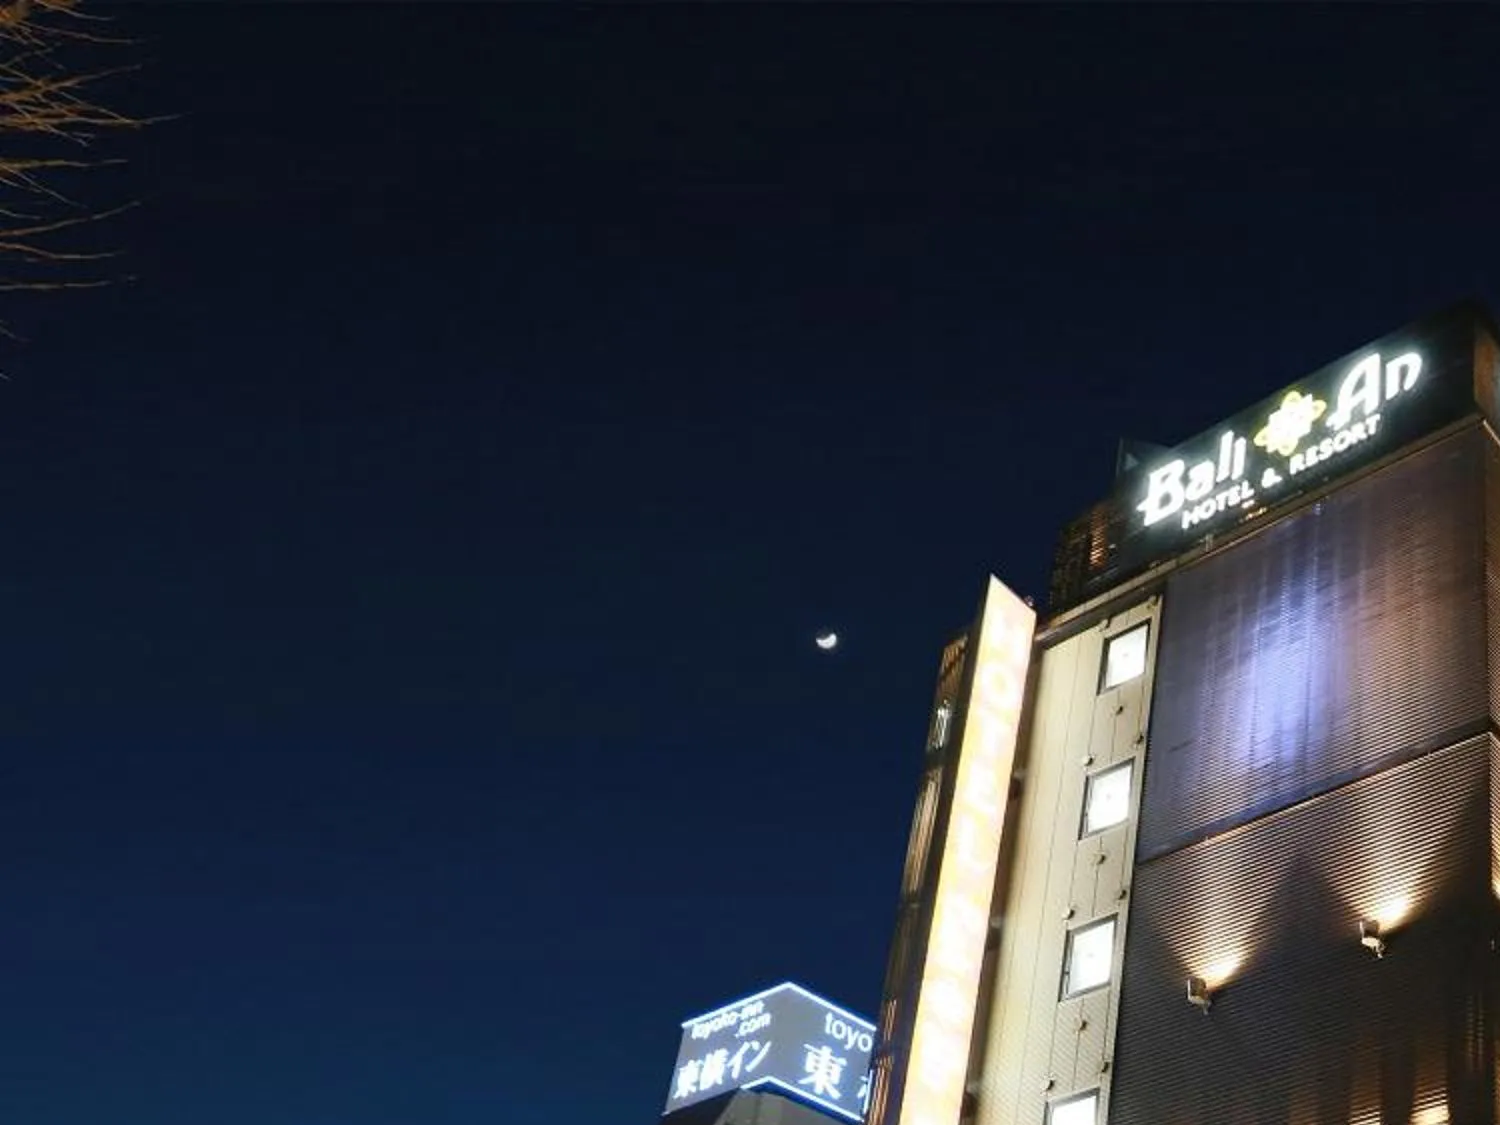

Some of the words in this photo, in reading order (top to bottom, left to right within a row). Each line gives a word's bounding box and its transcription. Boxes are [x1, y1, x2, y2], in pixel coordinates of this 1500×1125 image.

[1136, 430, 1247, 527] Bali
[1326, 352, 1423, 430] An
[1180, 479, 1255, 530] HOTEL
[1289, 413, 1381, 475] RESORT
